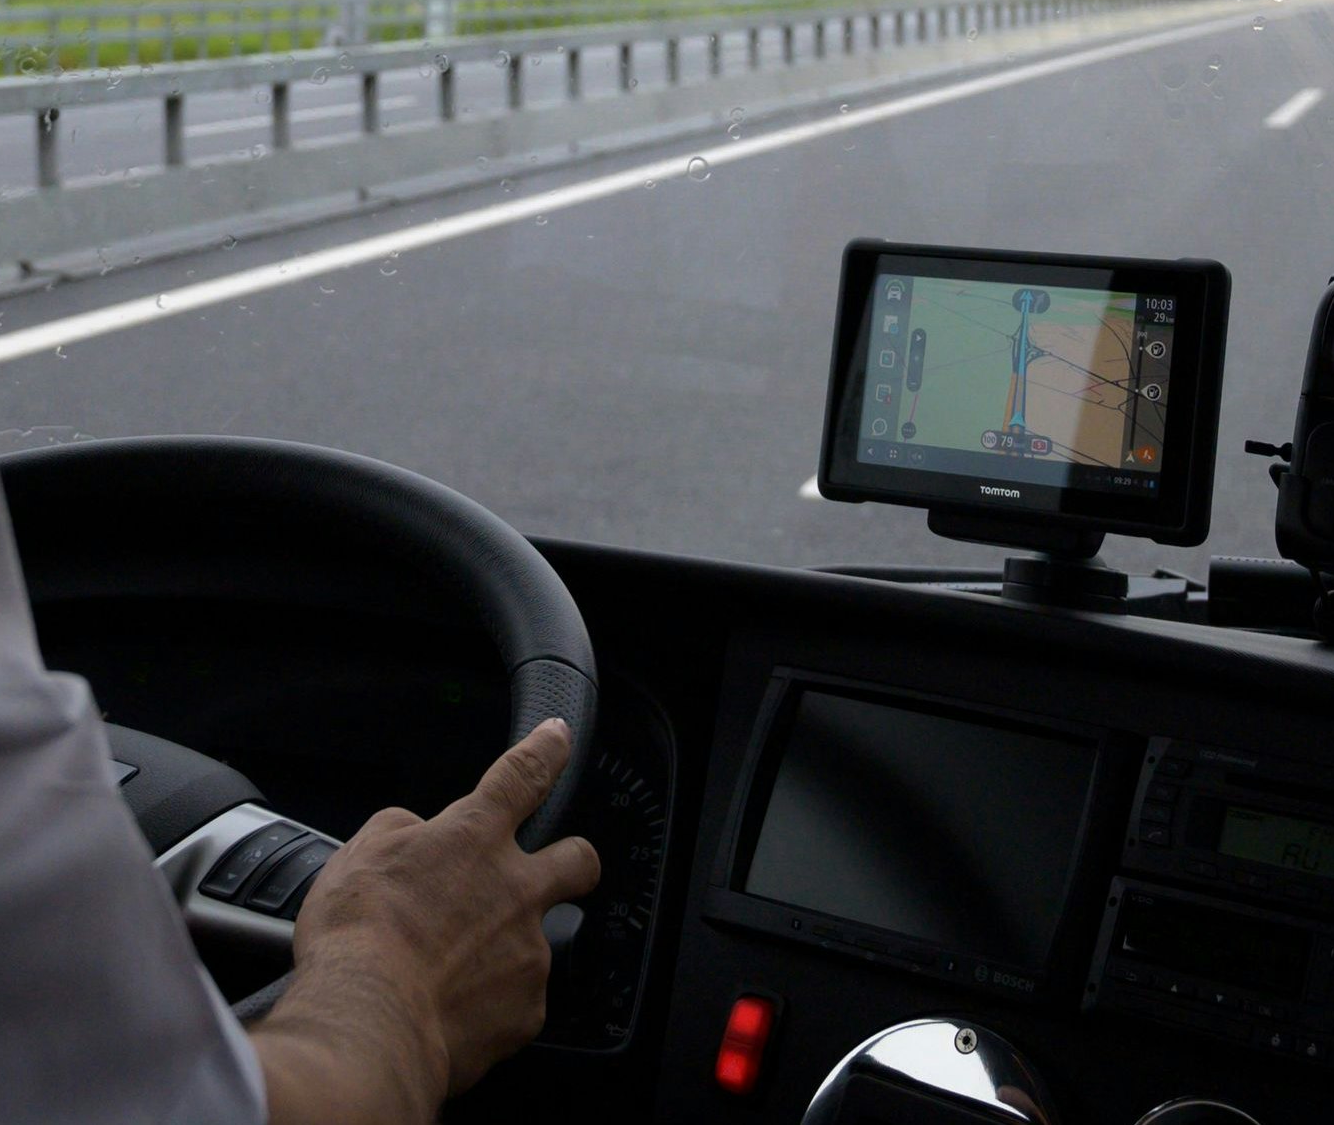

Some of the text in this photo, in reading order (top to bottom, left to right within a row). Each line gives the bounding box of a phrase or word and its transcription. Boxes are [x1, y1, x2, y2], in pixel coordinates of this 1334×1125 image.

[1145, 298, 1173, 311] 10:03
[1154, 312, 1165, 322] 29
[1001, 435, 1013, 448] 79
[610, 792, 630, 807] 20
[630, 846, 650, 860] 25
[608, 901, 628, 917] 30
[994, 971, 1036, 992] BOSCH
